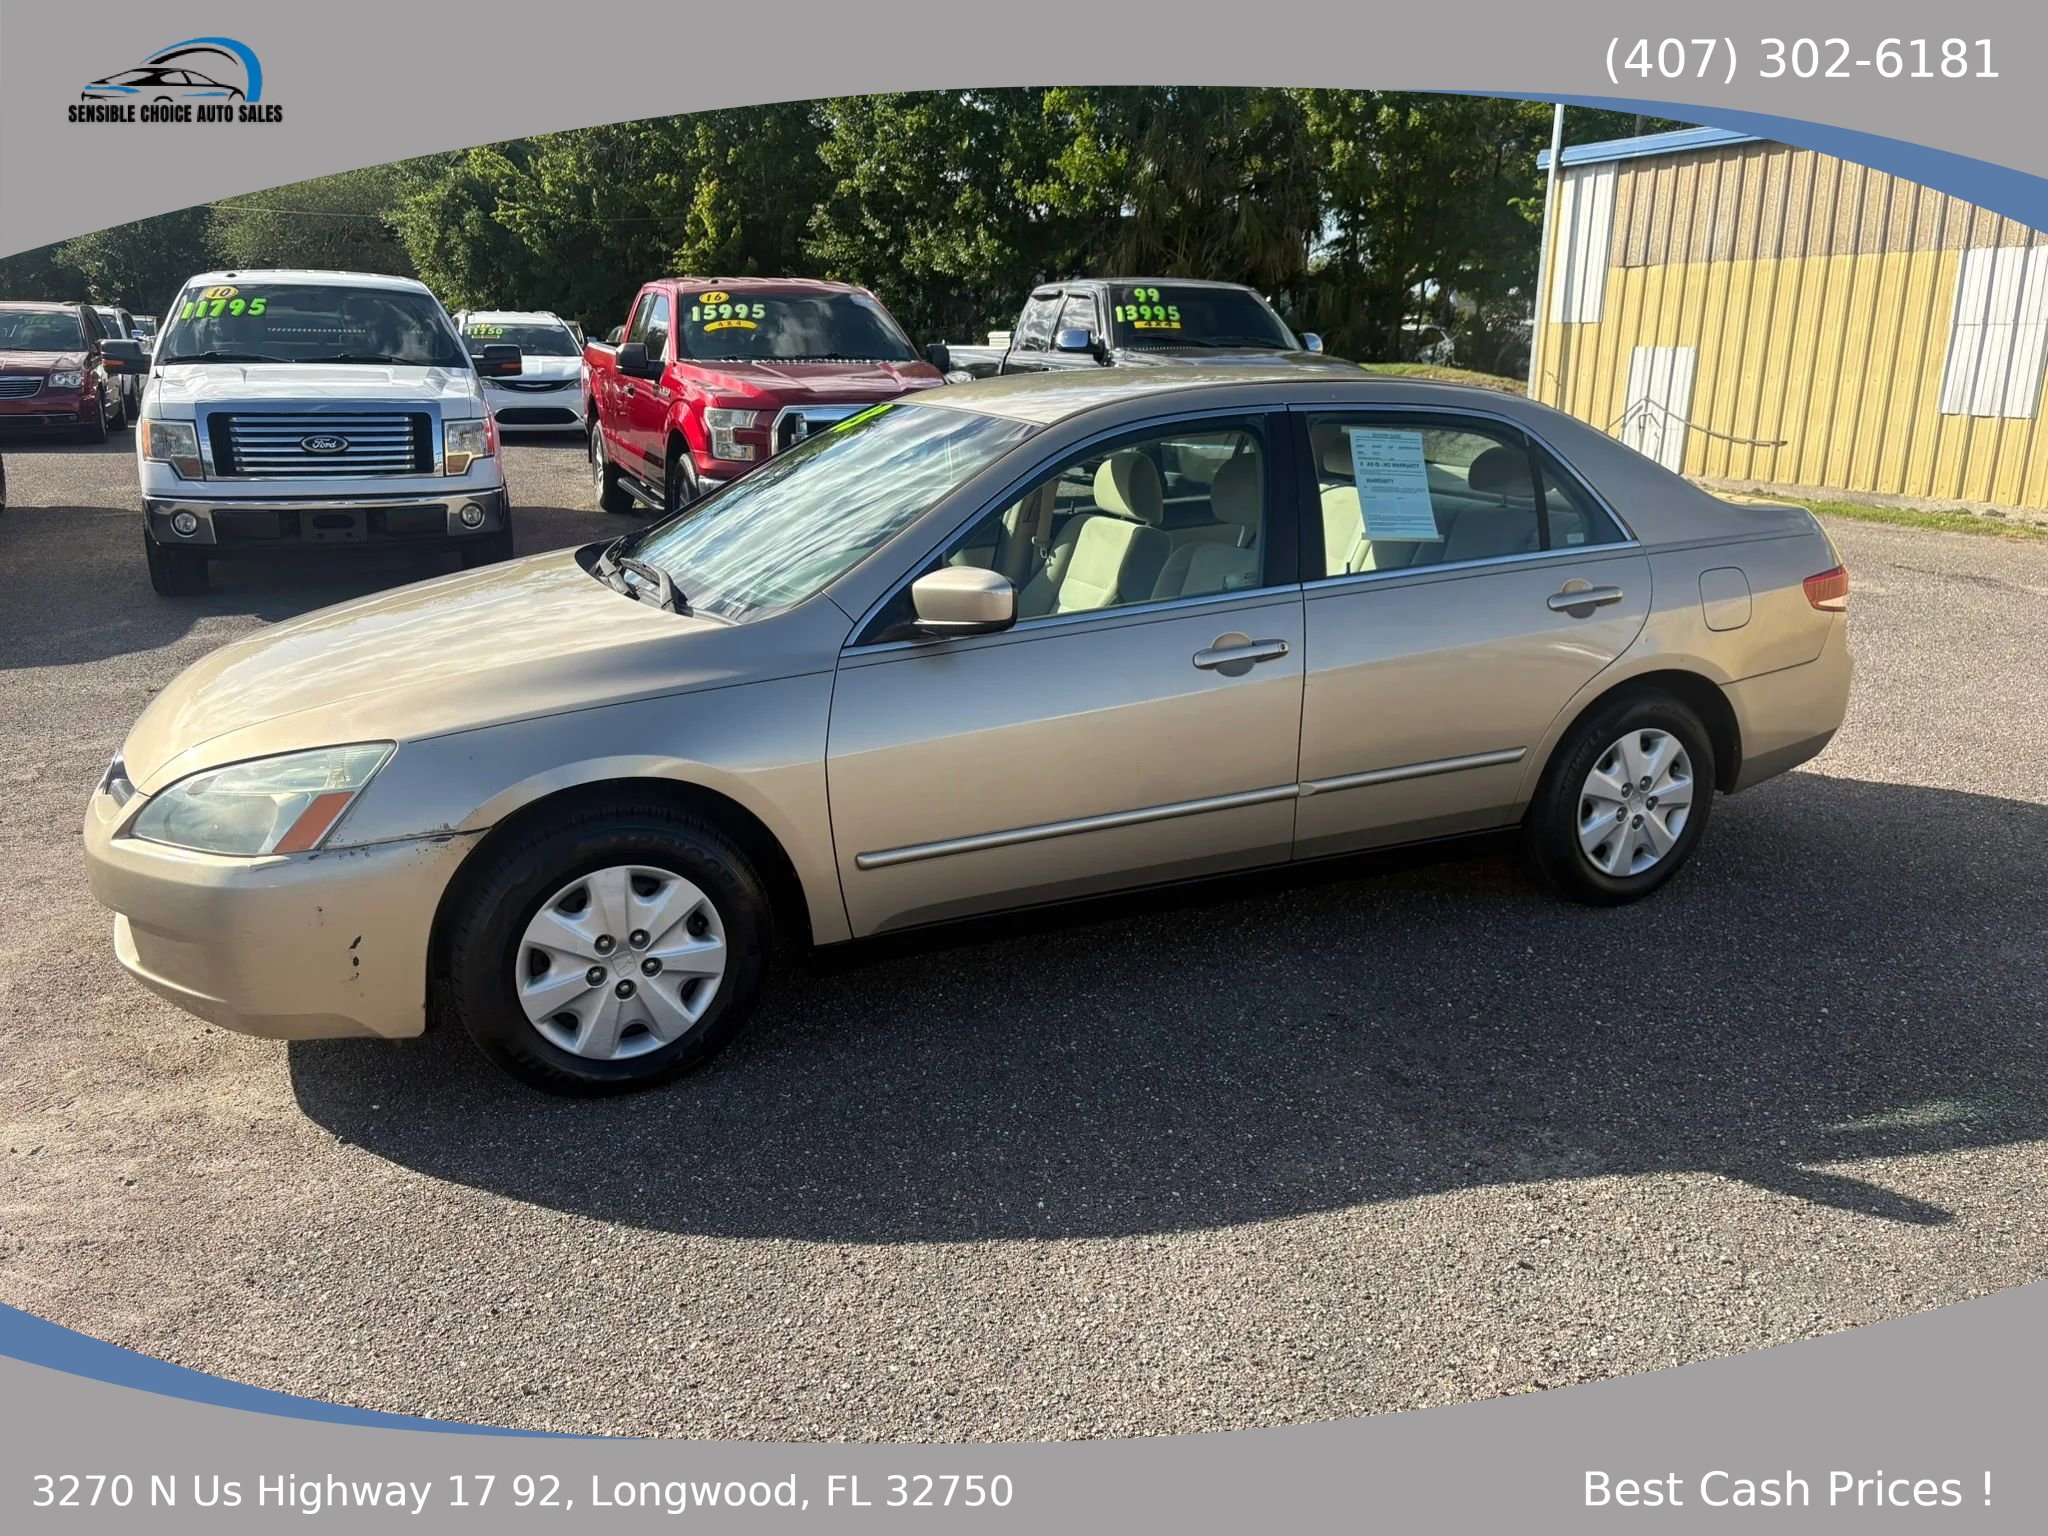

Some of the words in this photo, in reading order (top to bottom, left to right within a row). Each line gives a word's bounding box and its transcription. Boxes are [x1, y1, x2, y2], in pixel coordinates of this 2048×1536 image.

[211, 287, 232, 298] 10
[706, 293, 722, 302] 16
[1134, 287, 1160, 302] 99
[180, 298, 267, 320] 11795
[691, 303, 766, 322] 15995
[1115, 304, 1181, 322] 13995
[312, 438, 337, 449] Ford
